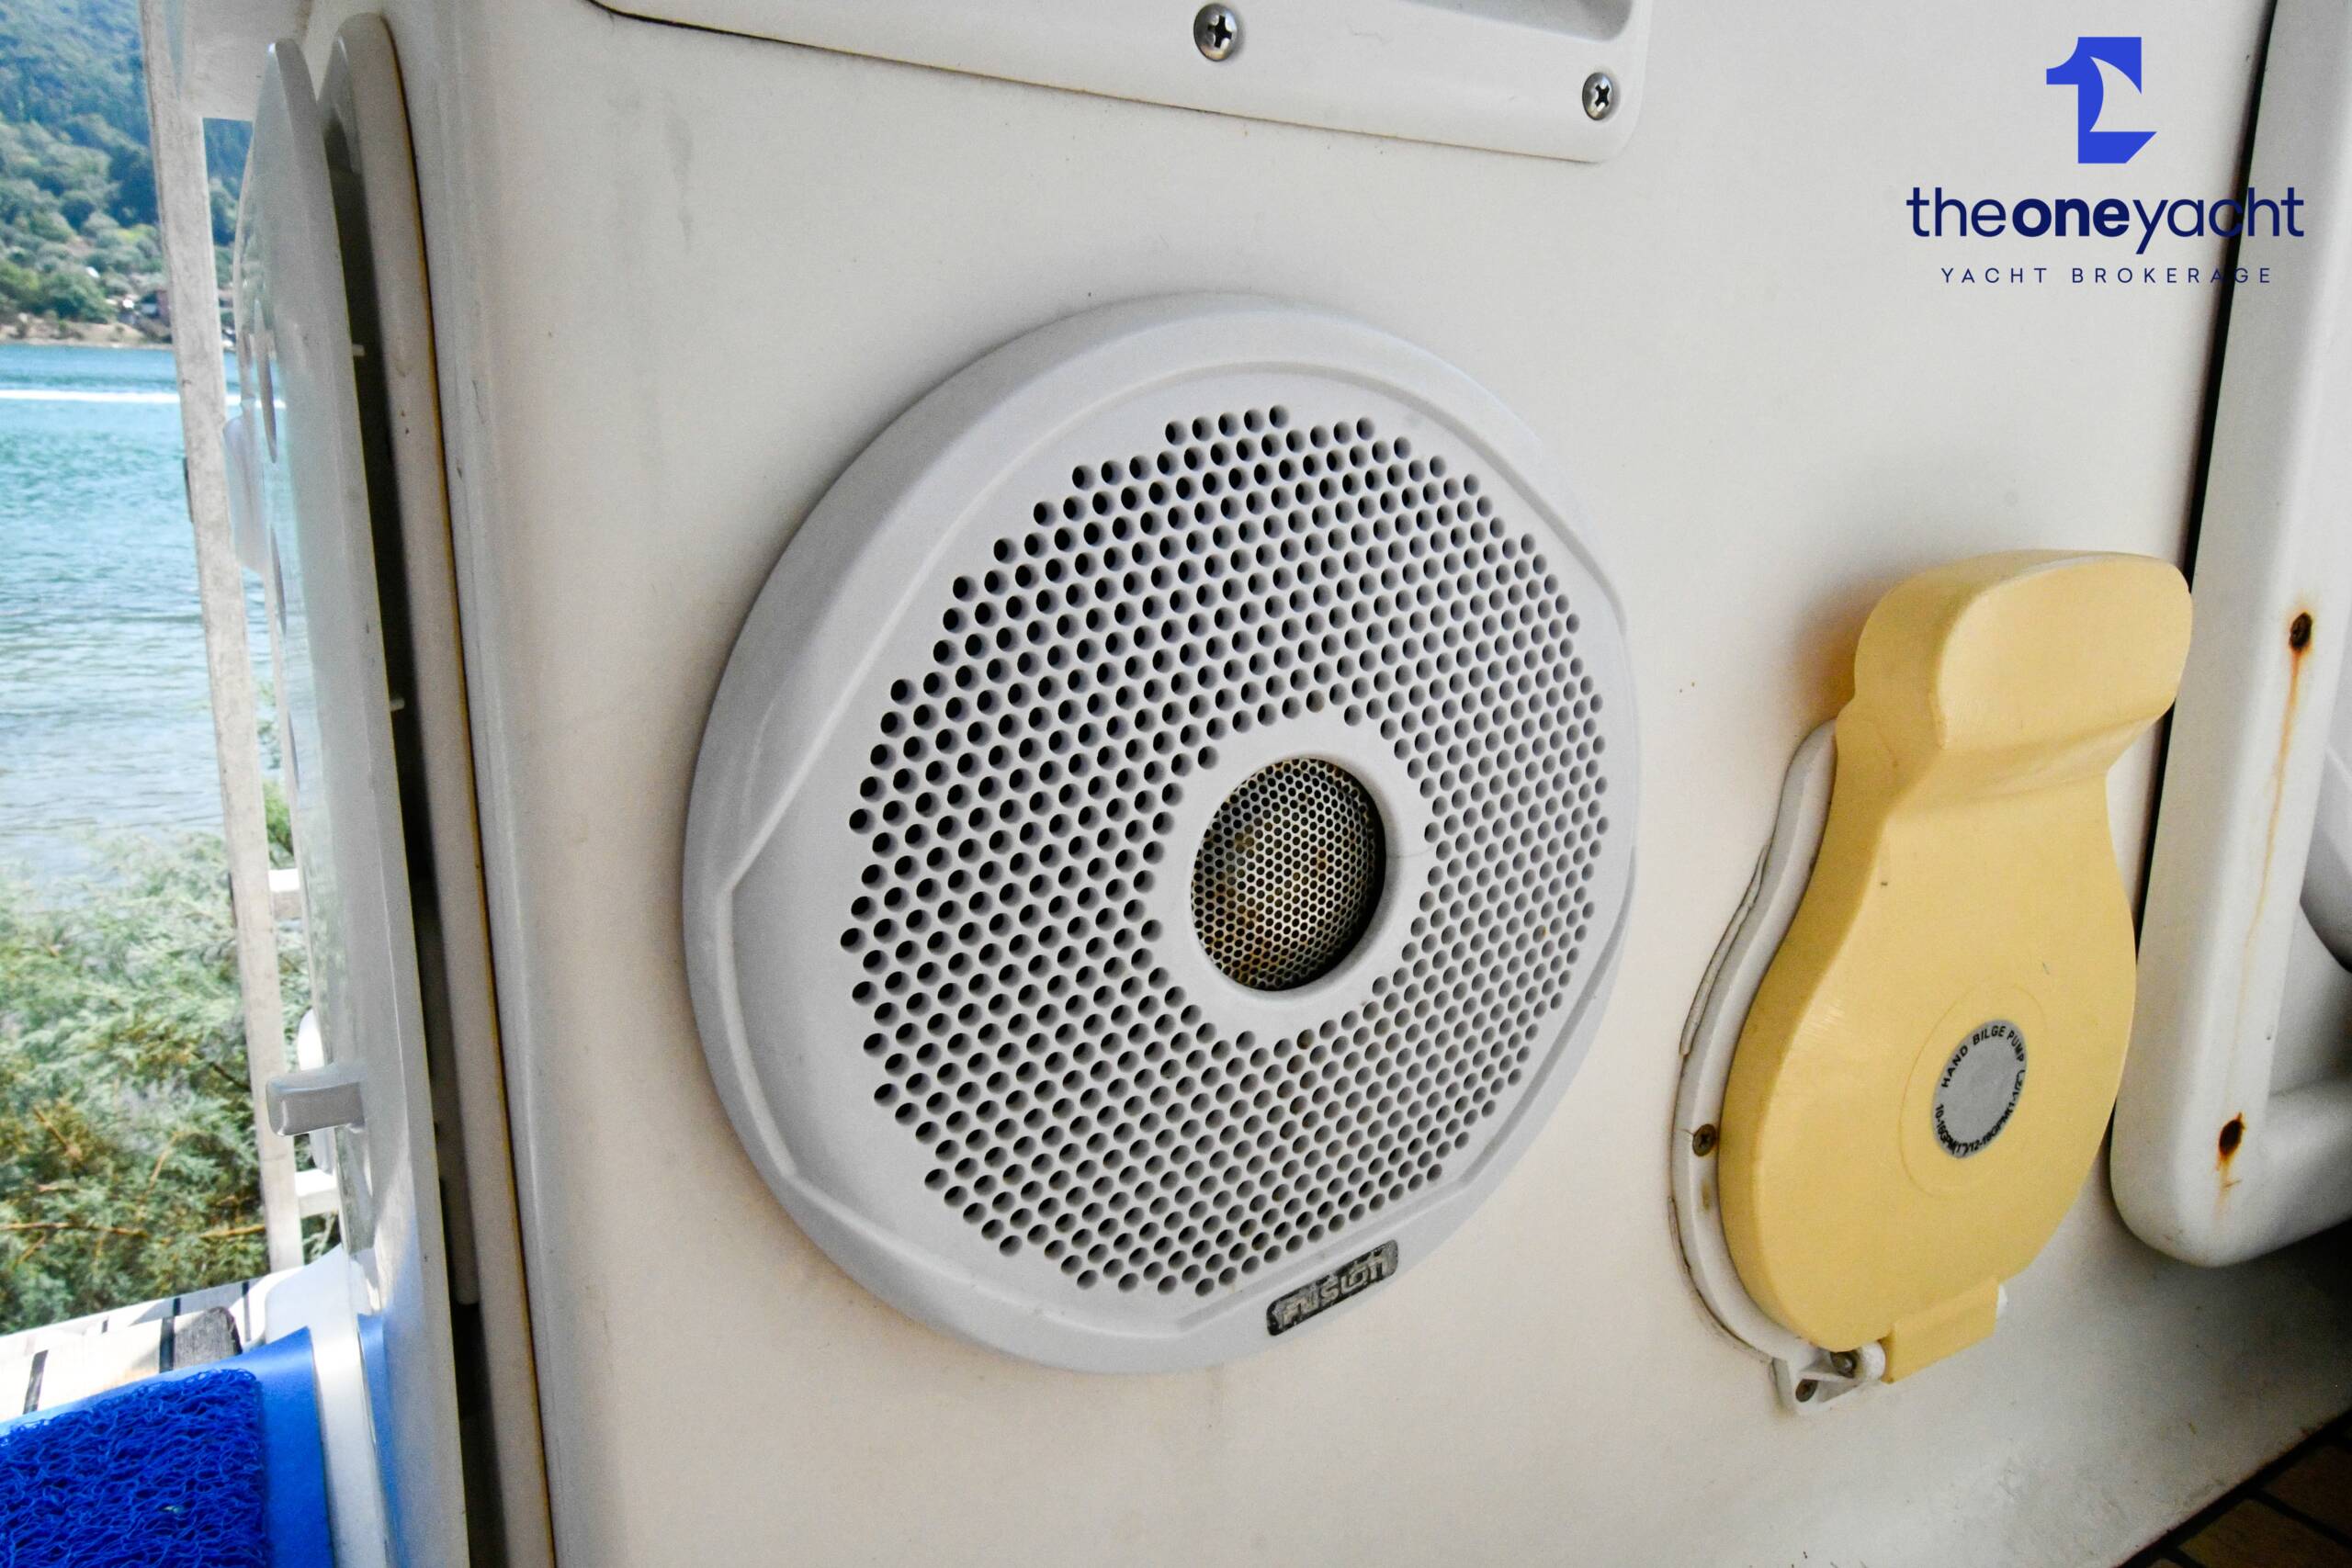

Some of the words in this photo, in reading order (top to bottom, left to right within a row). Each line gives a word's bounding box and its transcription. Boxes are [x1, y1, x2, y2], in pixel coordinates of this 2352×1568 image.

[1940, 1044, 1969, 1089] HAND
[1973, 1024, 2007, 1046] BILGE
[2006, 1030, 2026, 1063] PUMP
